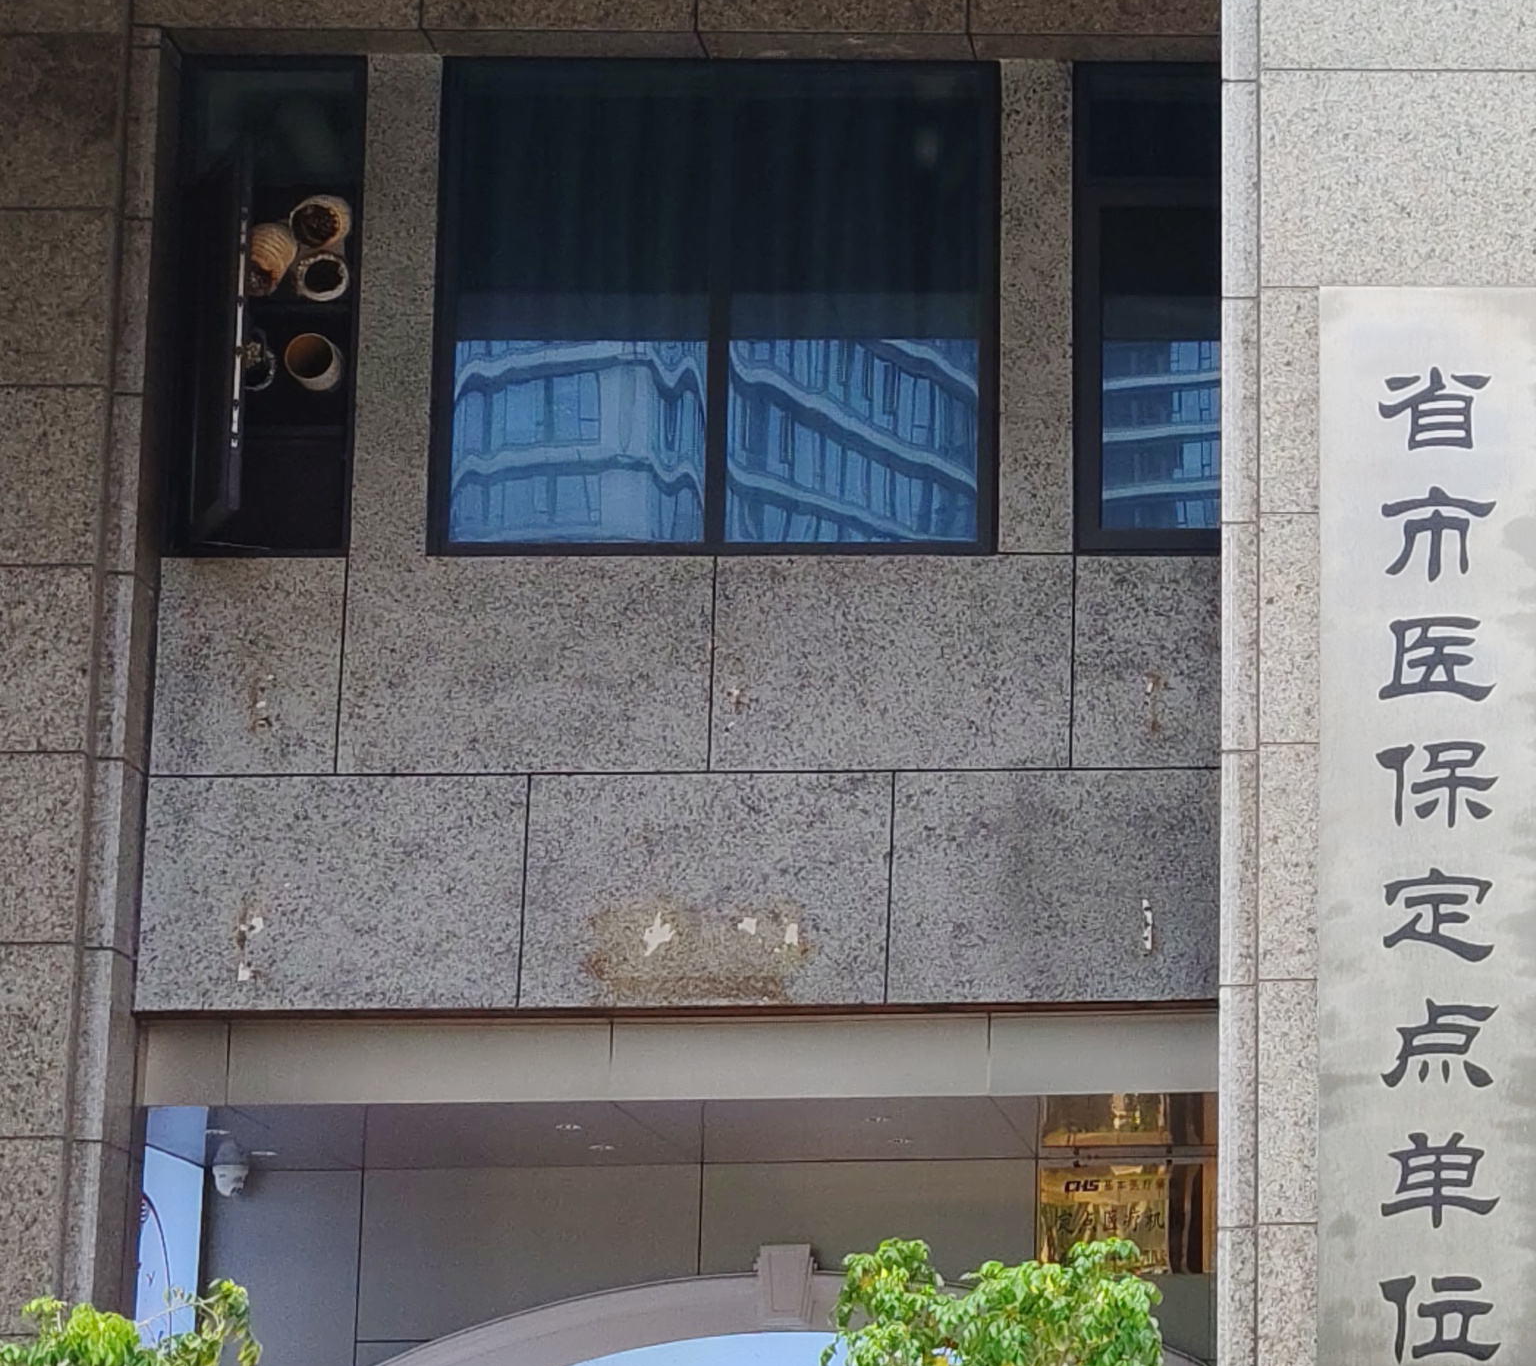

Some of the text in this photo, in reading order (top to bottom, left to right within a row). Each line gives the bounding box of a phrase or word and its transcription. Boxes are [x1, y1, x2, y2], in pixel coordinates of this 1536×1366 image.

[1376, 365, 1503, 1366] 省市医保定点单位
